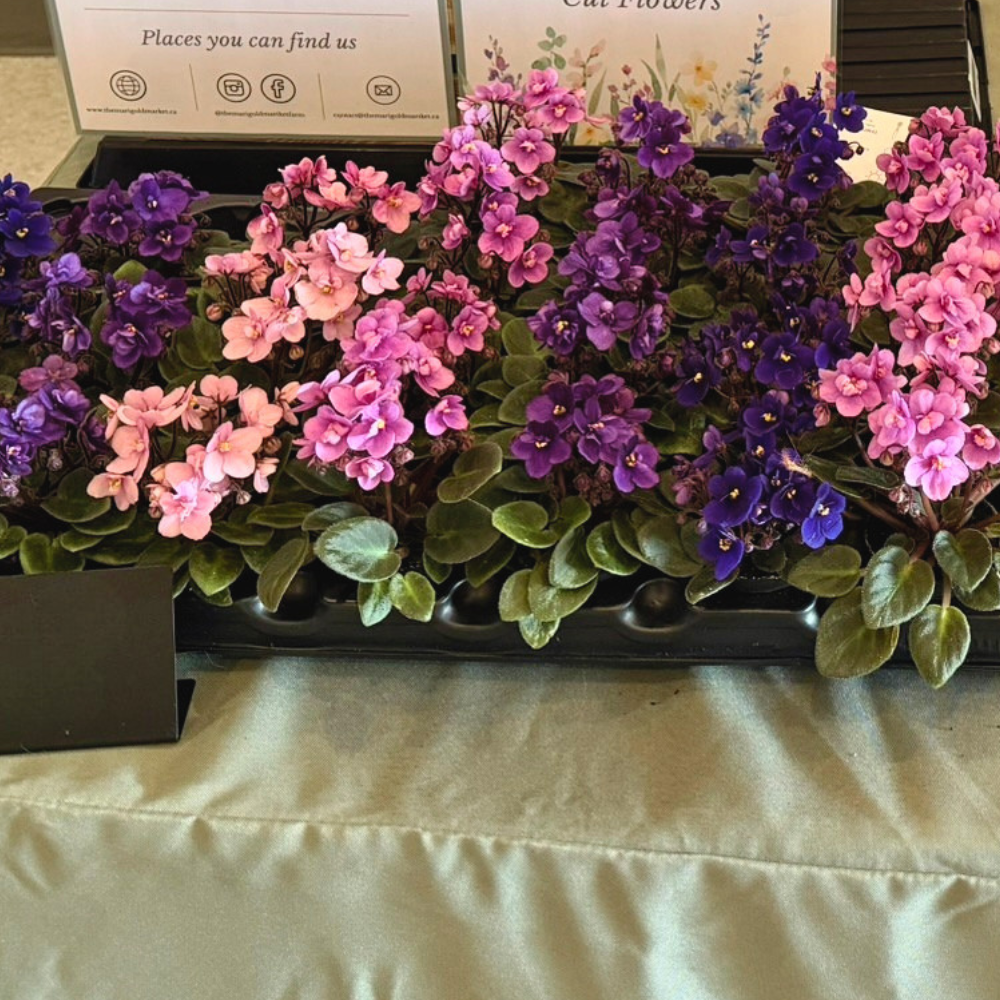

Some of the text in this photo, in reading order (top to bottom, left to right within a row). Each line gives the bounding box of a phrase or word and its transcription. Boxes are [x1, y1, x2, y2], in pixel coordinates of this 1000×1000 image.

[141, 28, 357, 53] Places you can find us
